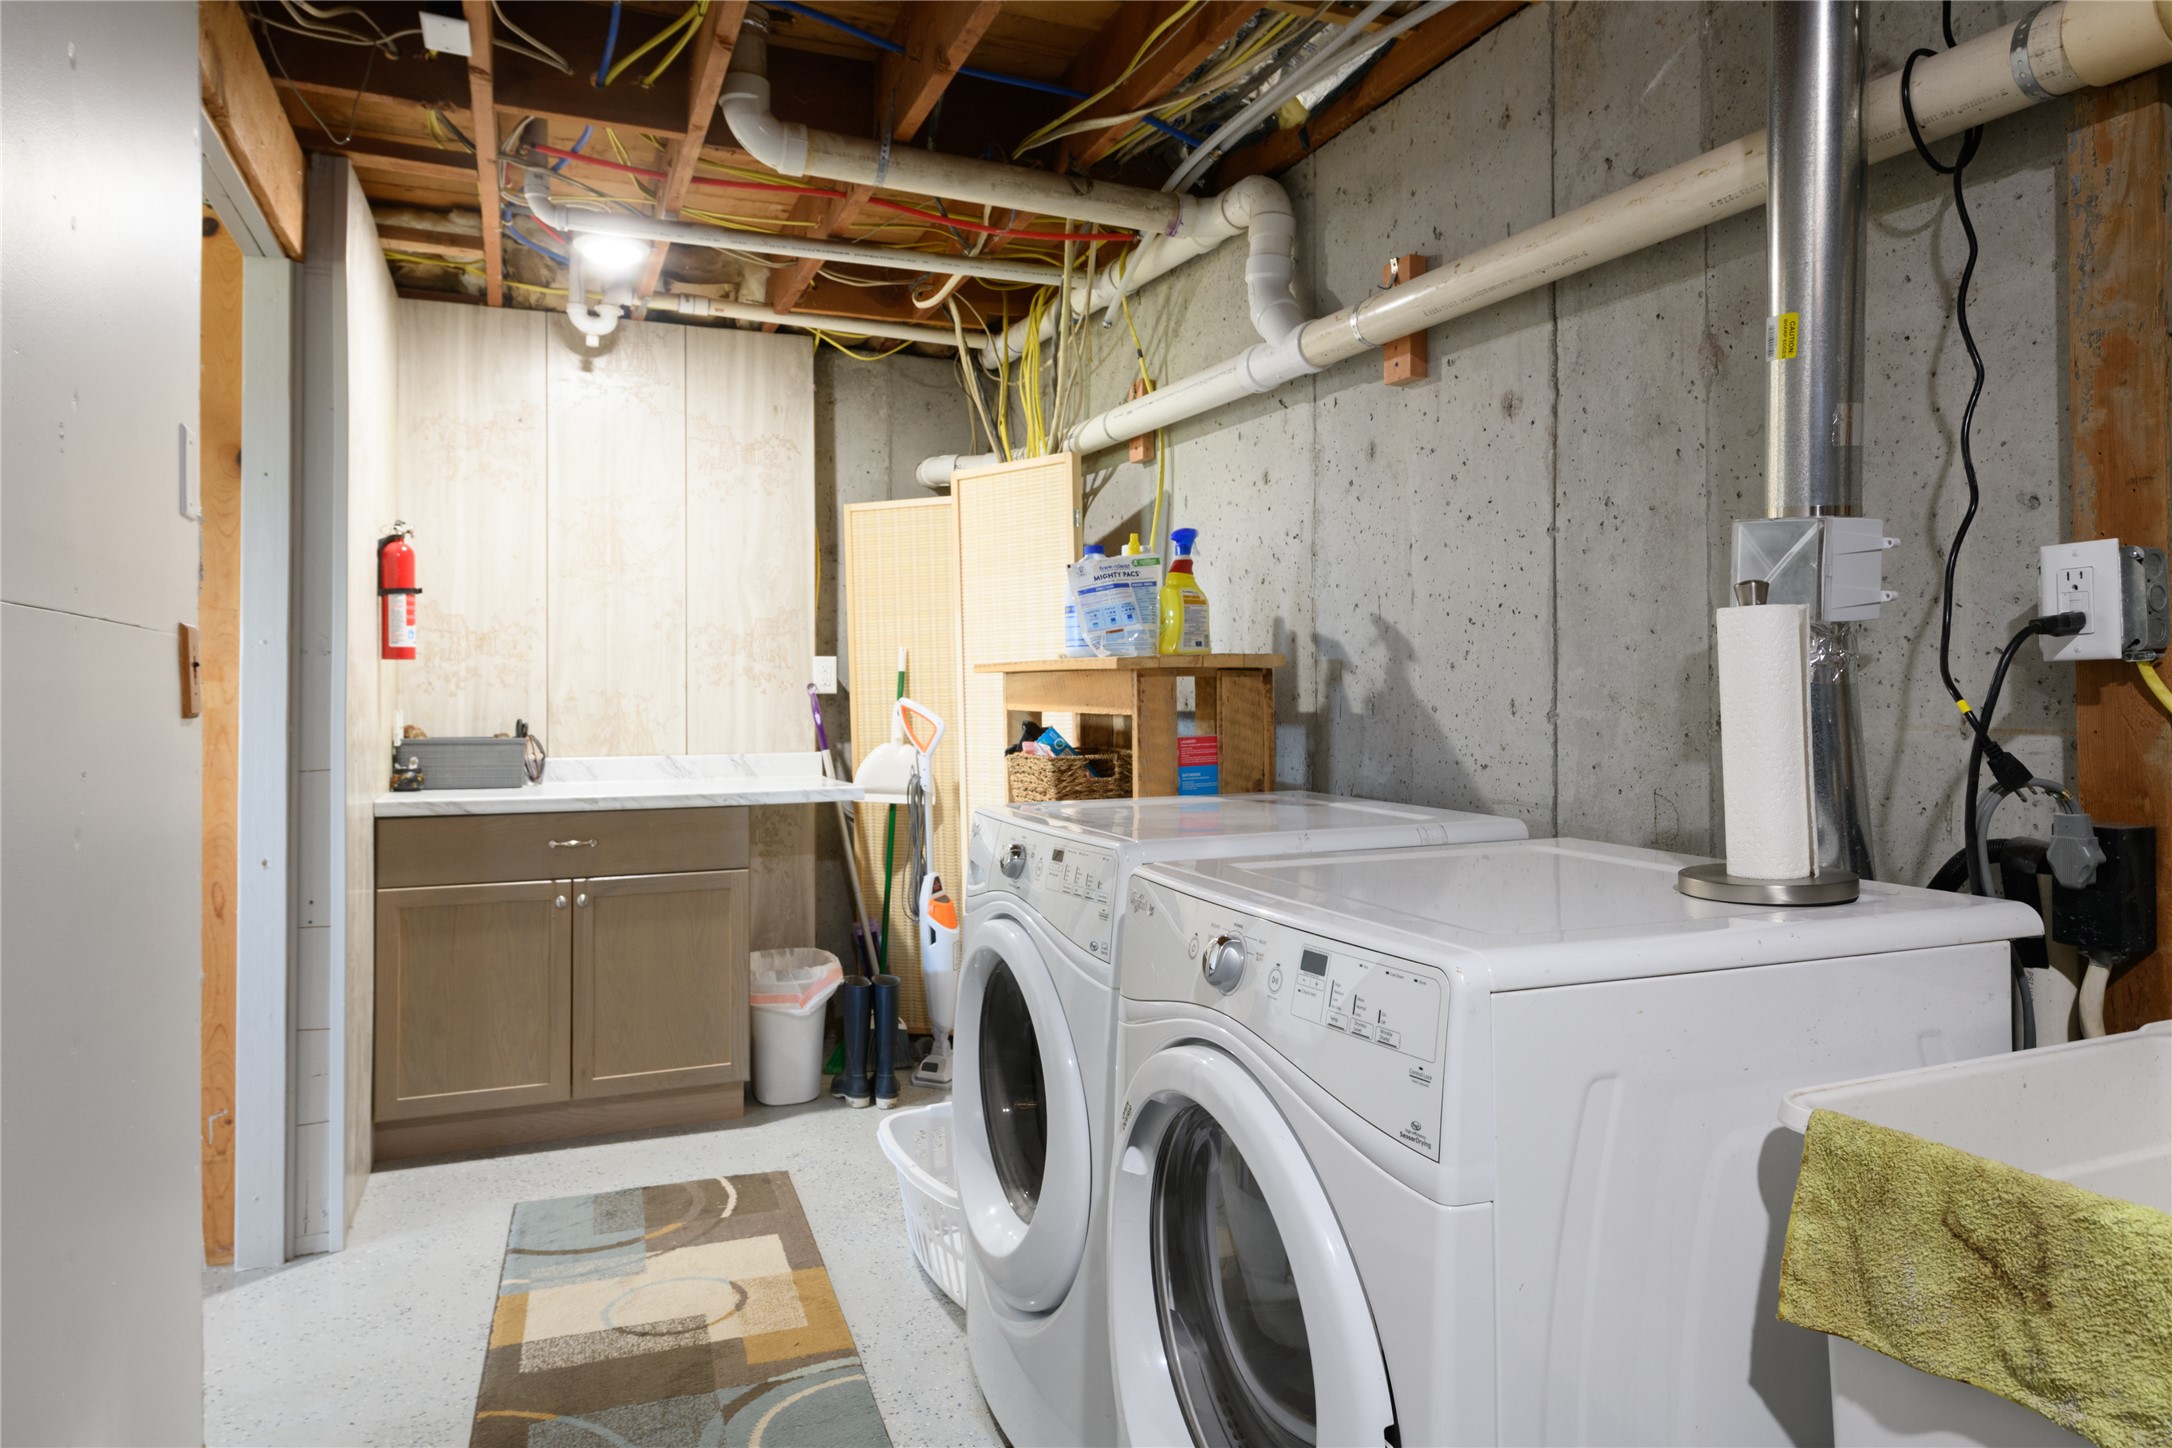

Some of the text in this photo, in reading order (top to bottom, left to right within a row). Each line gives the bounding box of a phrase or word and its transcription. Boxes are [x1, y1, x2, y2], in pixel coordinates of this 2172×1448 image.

[1094, 571, 1121, 582] MIGHTY
[1354, 1020, 1367, 1029] Dryness
[1400, 1131, 1431, 1150] SensorDrying
